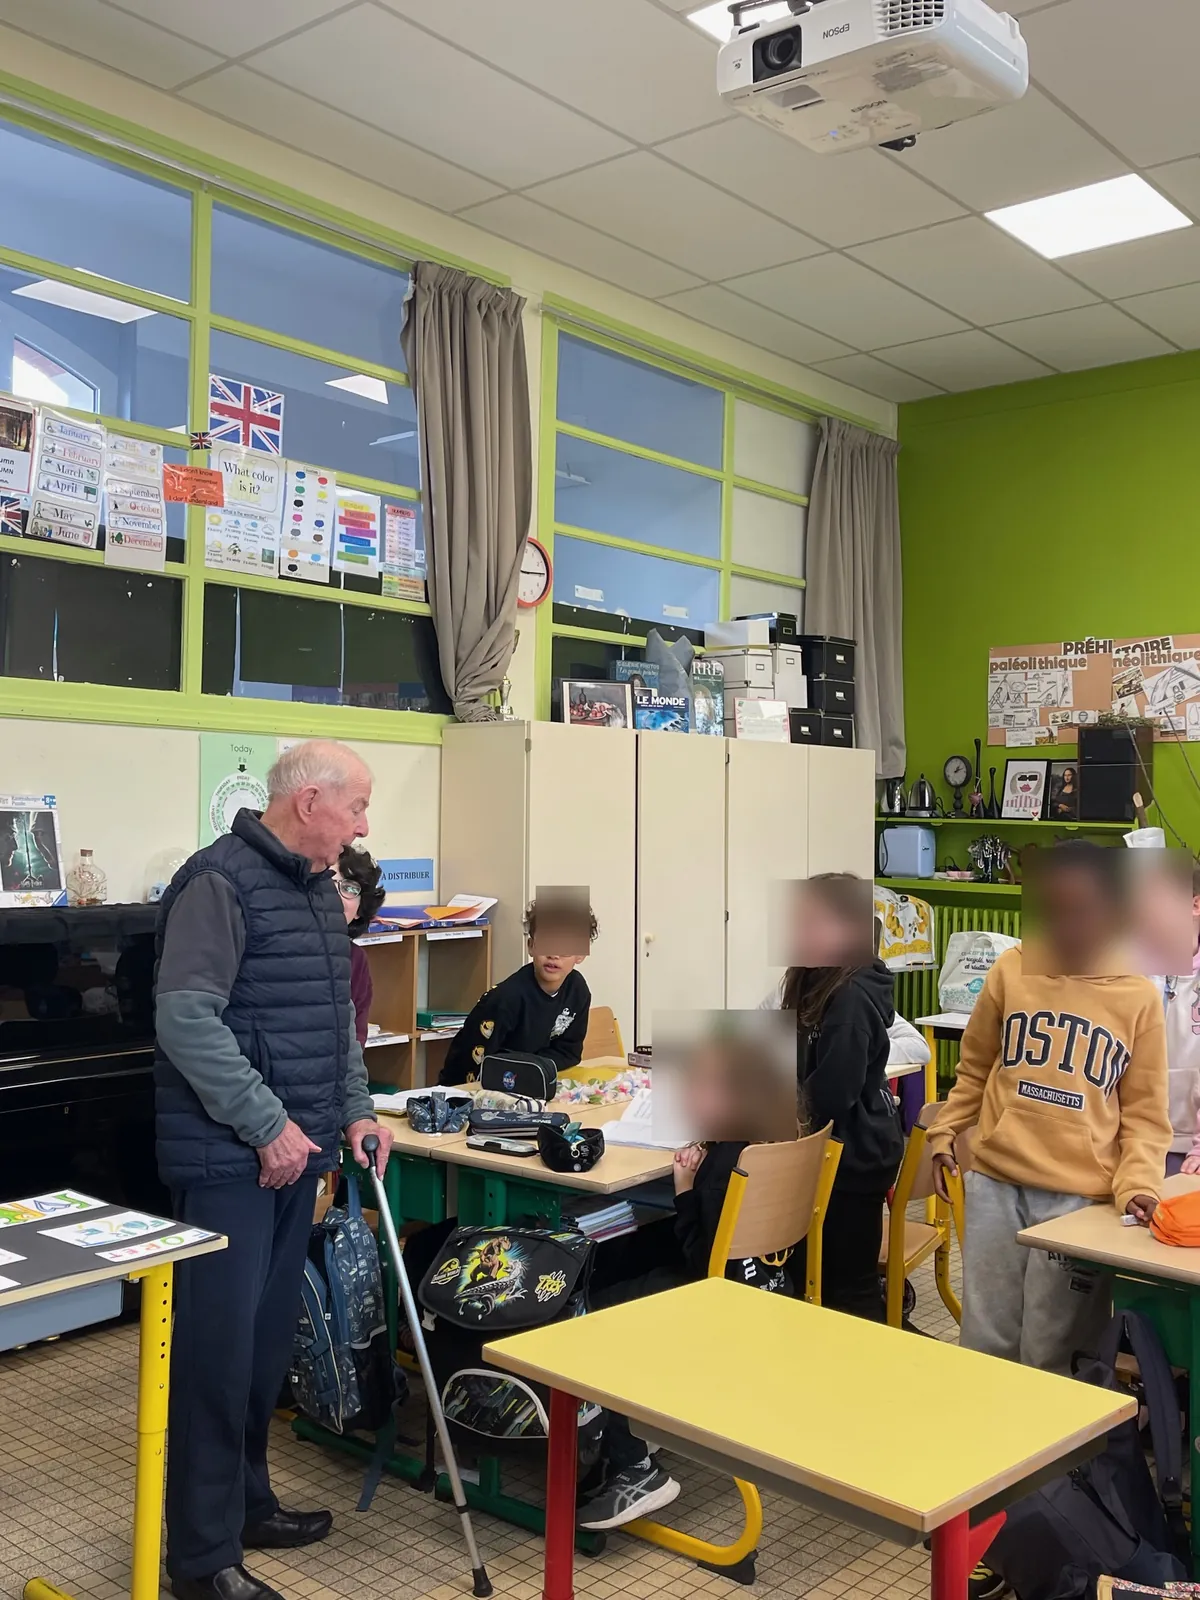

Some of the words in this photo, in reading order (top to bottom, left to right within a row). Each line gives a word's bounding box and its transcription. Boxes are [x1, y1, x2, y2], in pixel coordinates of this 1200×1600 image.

[822, 23, 850, 39] EPSON
[59, 425, 91, 443] January
[62, 447, 99, 465] February
[55, 463, 84, 479] March
[223, 461, 250, 477] What
[252, 470, 274, 484] color
[53, 480, 78, 494] April
[239, 480, 247, 492] is
[249, 482, 261, 495] it?
[53, 508, 75, 523] May
[129, 503, 160, 514] October
[122, 516, 161, 531] November
[56, 526, 80, 540] June
[123, 534, 161, 548] December
[989, 656, 1087, 674] paléolithique
[636, 696, 649, 705] LE
[651, 697, 686, 706] MONDE
[388, 871, 430, 880] DISTRIBUER
[1020, 1083, 1081, 1107] MASSACHUSETTS
